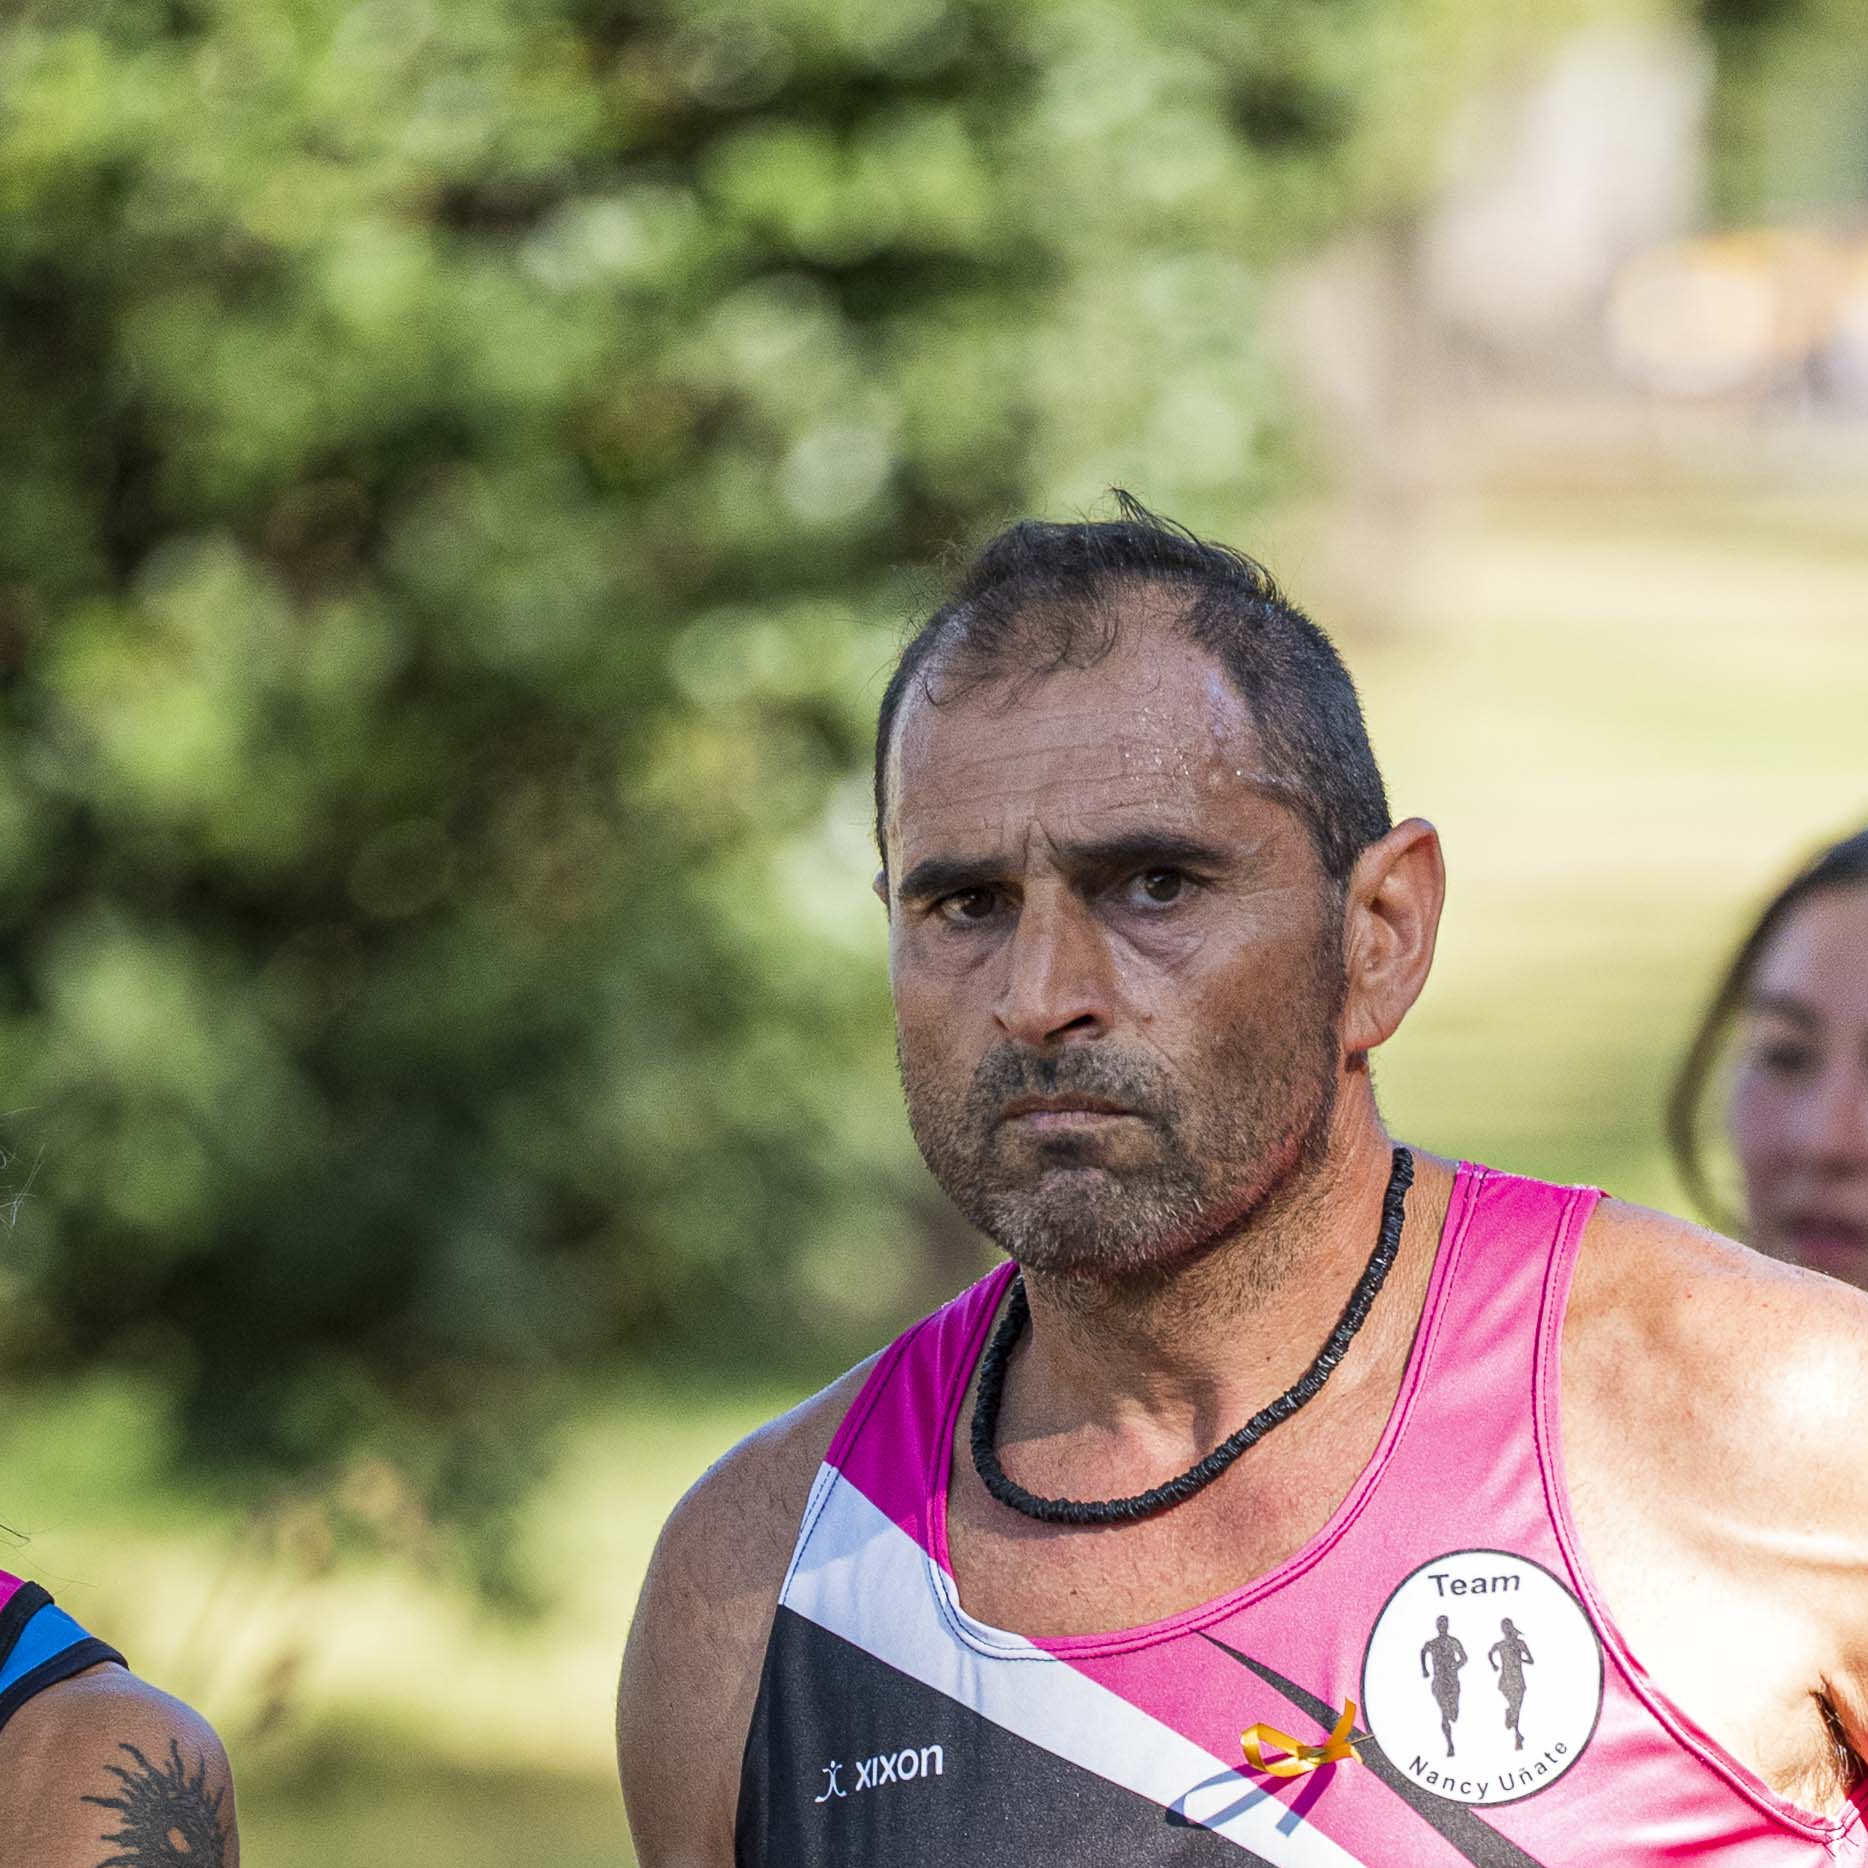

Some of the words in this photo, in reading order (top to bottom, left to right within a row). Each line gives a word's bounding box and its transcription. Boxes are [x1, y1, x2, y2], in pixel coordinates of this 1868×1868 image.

[1427, 1573, 1521, 1597] Team
[1408, 1755, 1489, 1800] Nancy
[1498, 1740, 1568, 1791] Uñate
